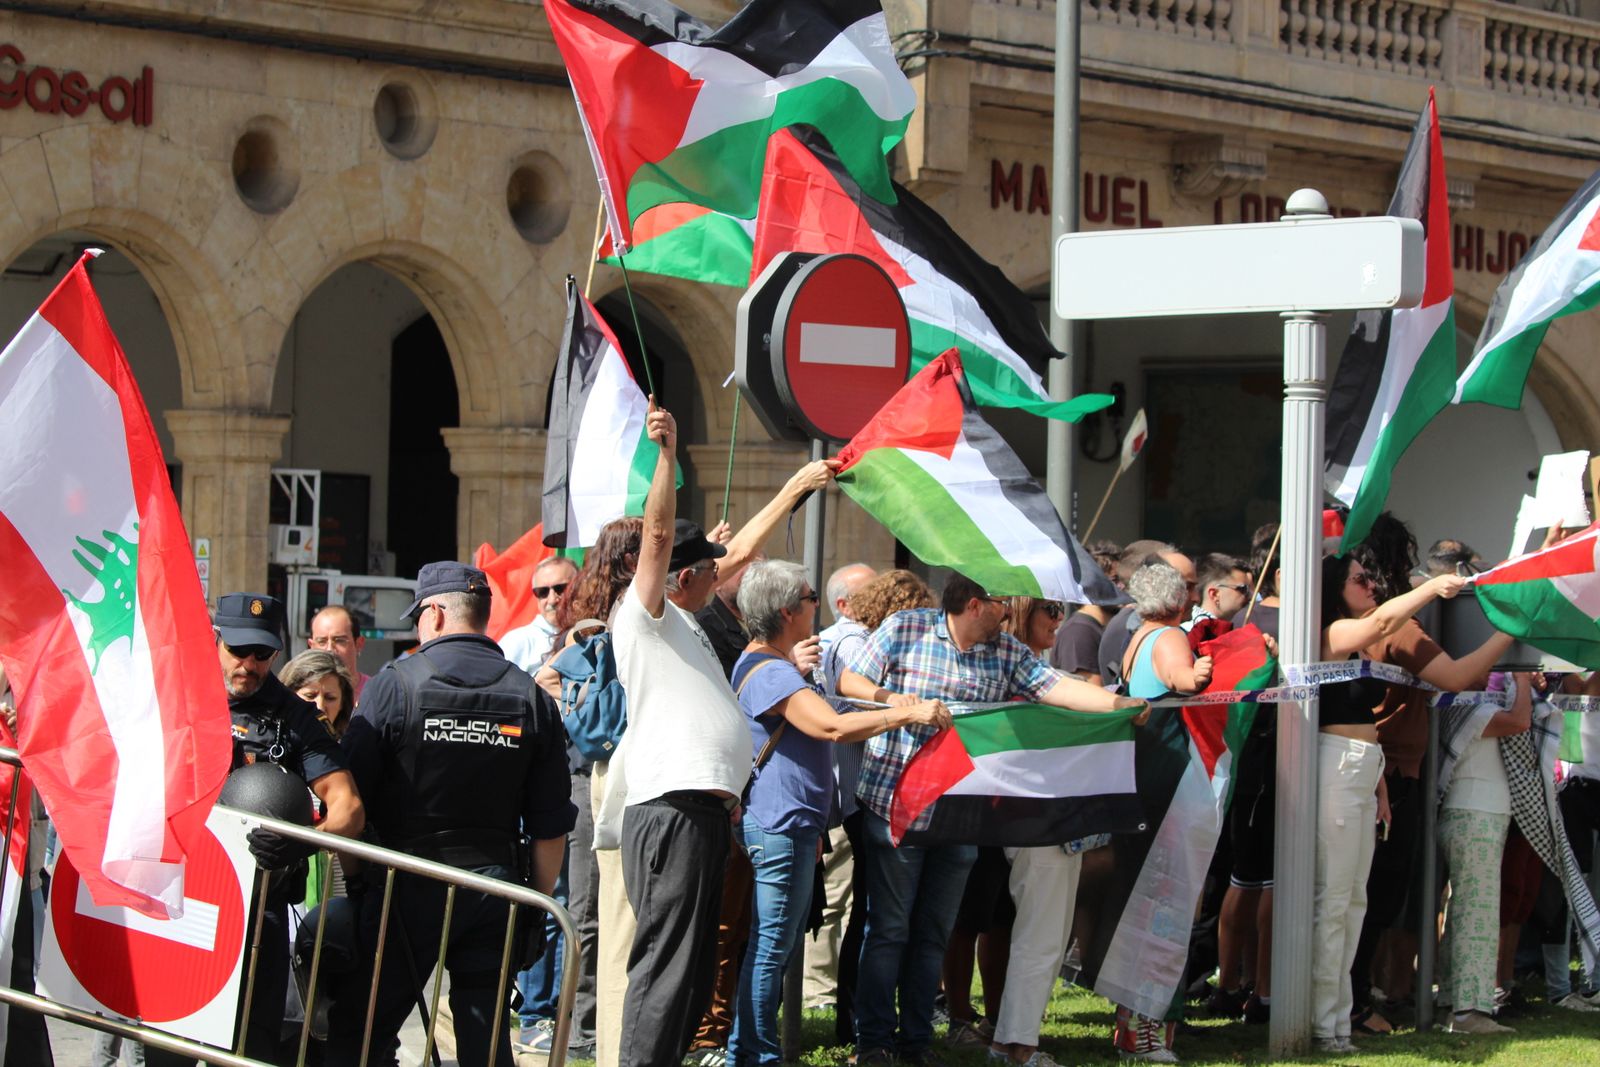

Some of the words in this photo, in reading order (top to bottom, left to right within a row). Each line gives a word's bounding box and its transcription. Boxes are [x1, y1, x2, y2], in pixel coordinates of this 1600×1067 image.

[988, 159, 1163, 228] MAUEL
[1453, 223, 1540, 275] HIJO
[1304, 673, 1320, 685] NO
[1322, 669, 1358, 682] PASAR
[1259, 692, 1278, 700] CNP
[1293, 689, 1306, 700] NO
[424, 718, 501, 735] POLICIA
[423, 730, 520, 749] NACIONAL
